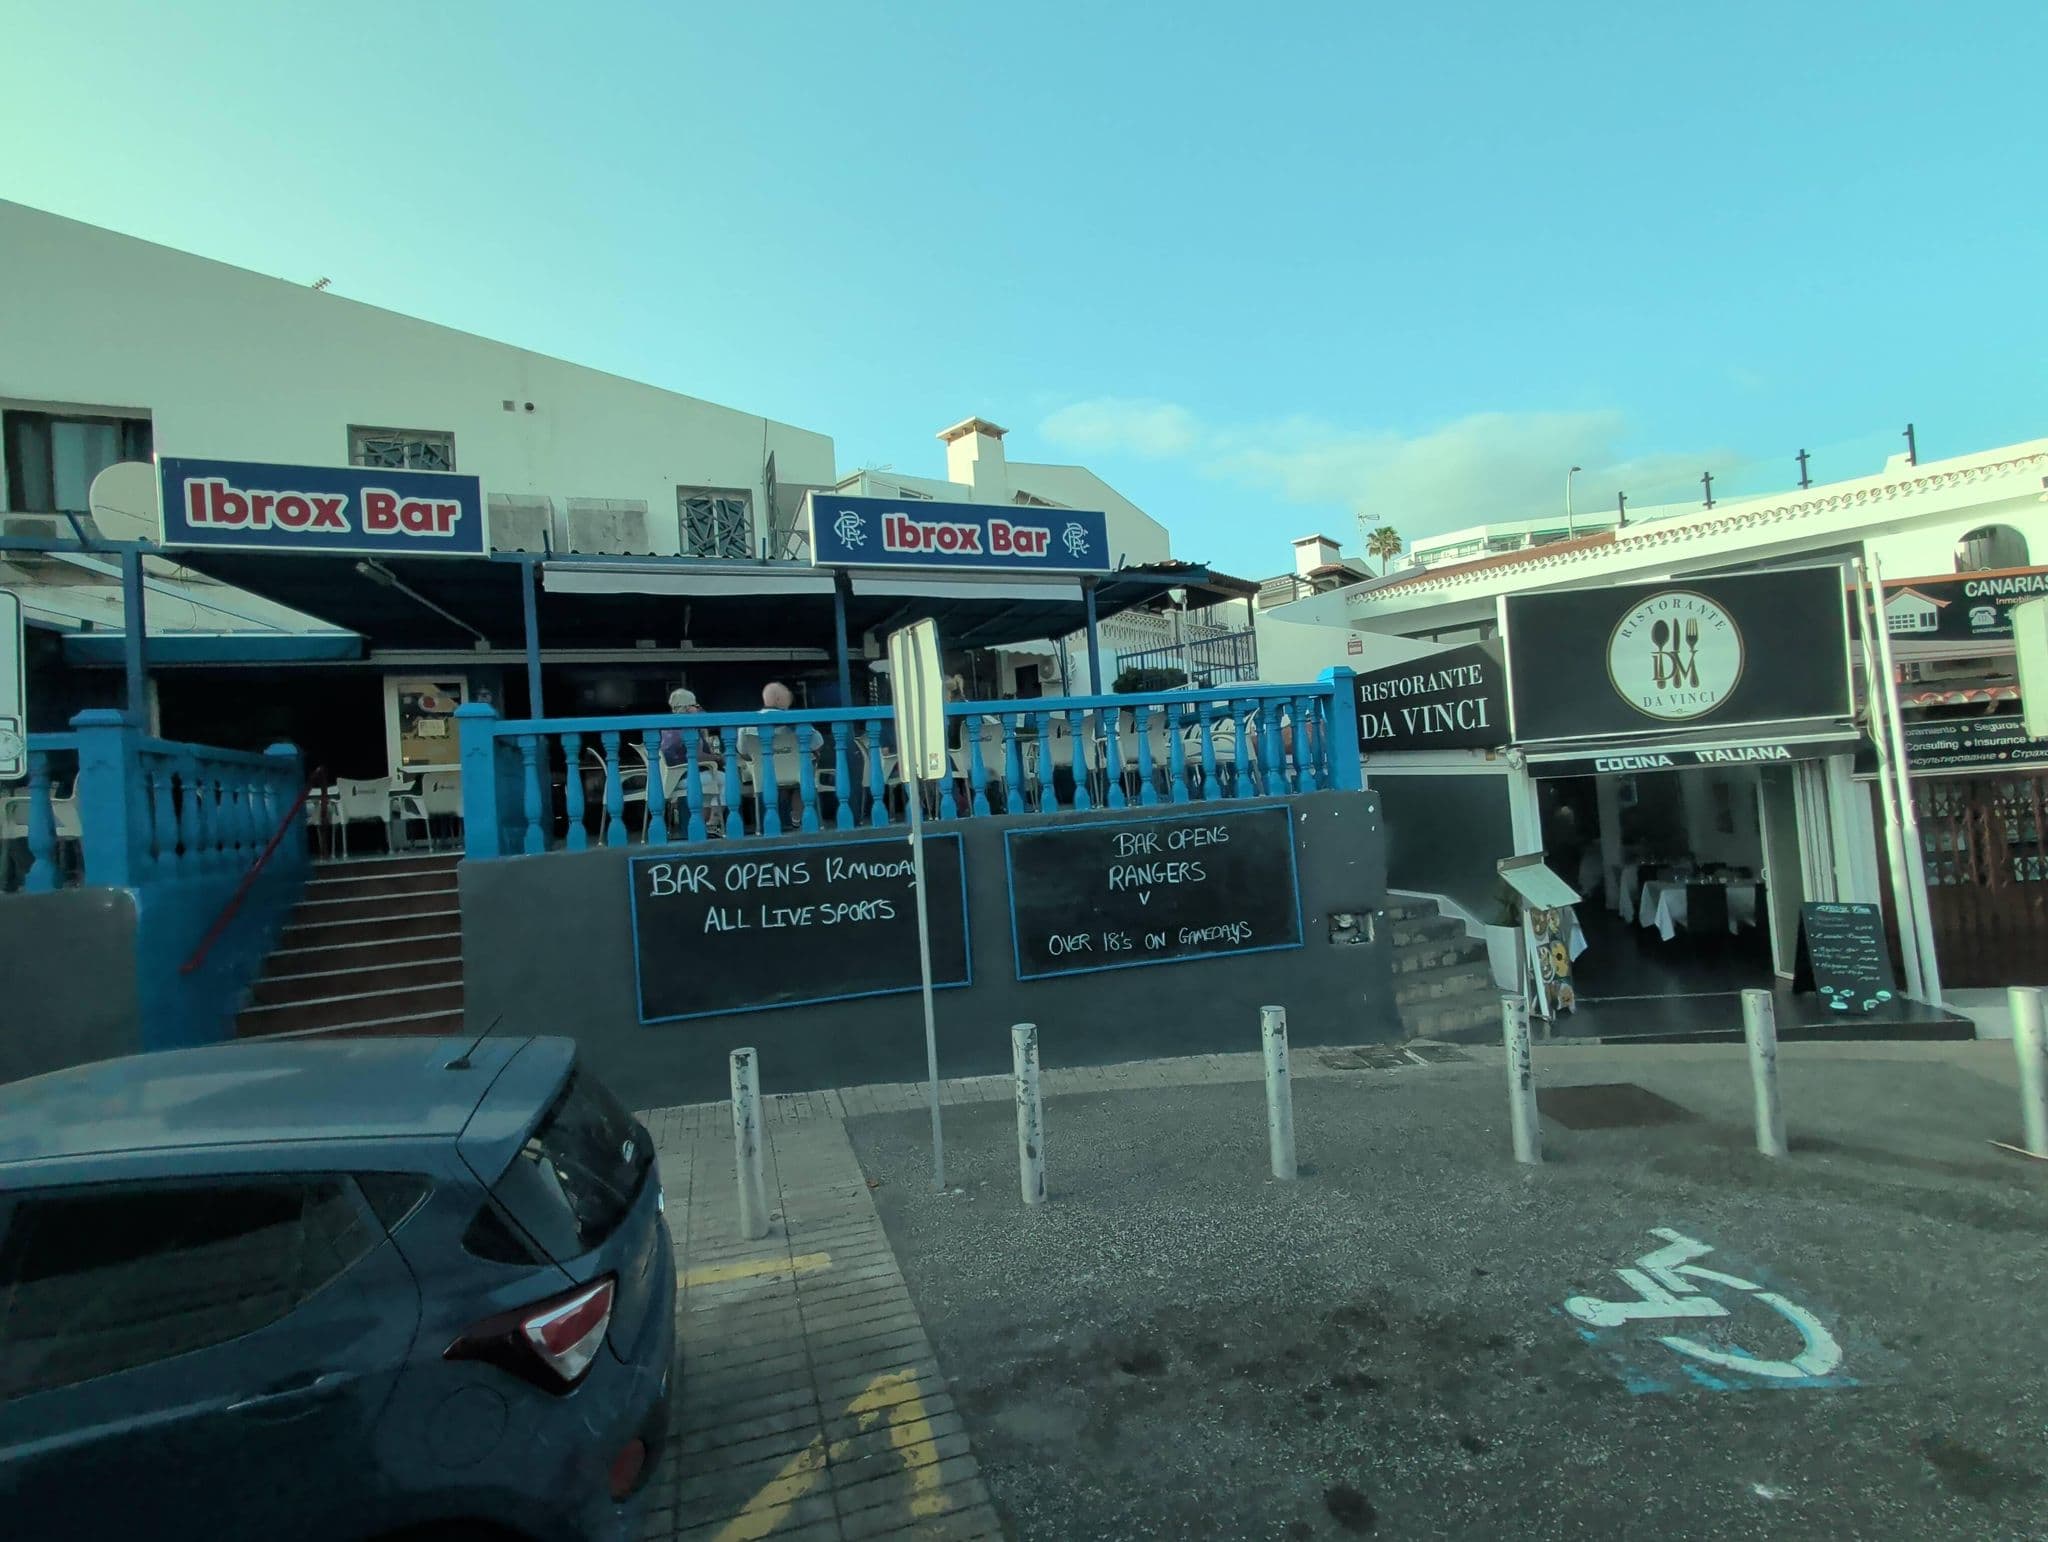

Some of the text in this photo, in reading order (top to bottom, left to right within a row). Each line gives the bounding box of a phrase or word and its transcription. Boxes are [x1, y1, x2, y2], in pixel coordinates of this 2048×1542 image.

[184, 478, 461, 537] Ibrox Bar
[882, 513, 1050, 556] Ibrox Bar
[1621, 599, 1726, 638] RISTORANTE
[1360, 664, 1483, 703] RISTORANTE
[1643, 691, 1715, 708] DA VINCI
[1360, 697, 1490, 740] DA VINCI
[1595, 746, 1791, 772] COCINA ITALIANA
[1904, 735, 2026, 751] Consulting Insurance
[1112, 826, 1230, 858] BAR OPENS
[648, 863, 716, 897] BAR
[725, 861, 810, 891] OPENS
[1109, 862, 1206, 891] RANGERS
[704, 899, 896, 934] ALL LIVE SPORTS
[1049, 933, 1092, 956] OVER
[1145, 930, 1166, 950] ON
[1179, 920, 1252, 945] GAMEDAYS
